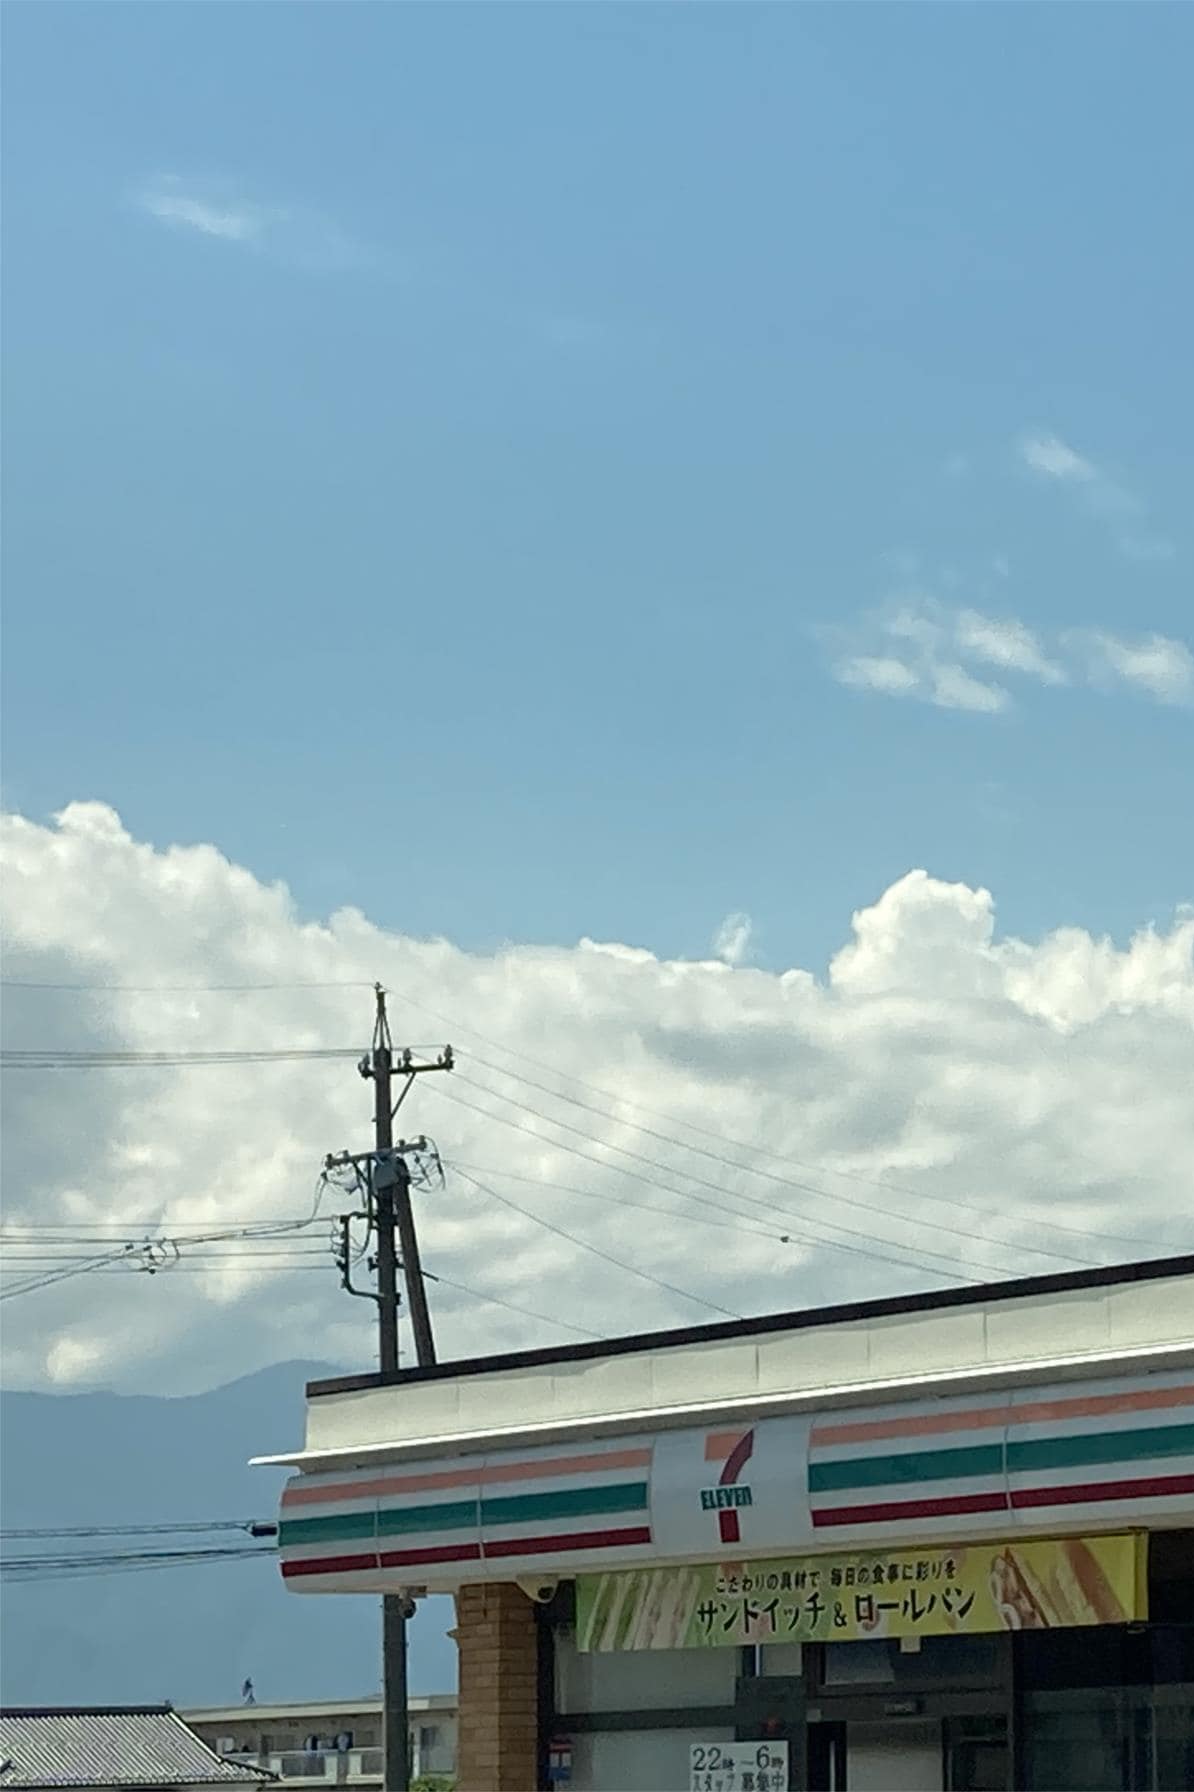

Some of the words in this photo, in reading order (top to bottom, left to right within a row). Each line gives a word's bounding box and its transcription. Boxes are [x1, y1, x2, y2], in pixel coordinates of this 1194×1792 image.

[703, 1427, 755, 1544] 7
[715, 1570, 821, 1593] こだわりの具材で
[830, 1558, 956, 1587] 毎日の食事に彩りを
[696, 1591, 826, 1634] サンドイッチ
[833, 1601, 848, 1627] &
[854, 1586, 976, 1623] ロールパン
